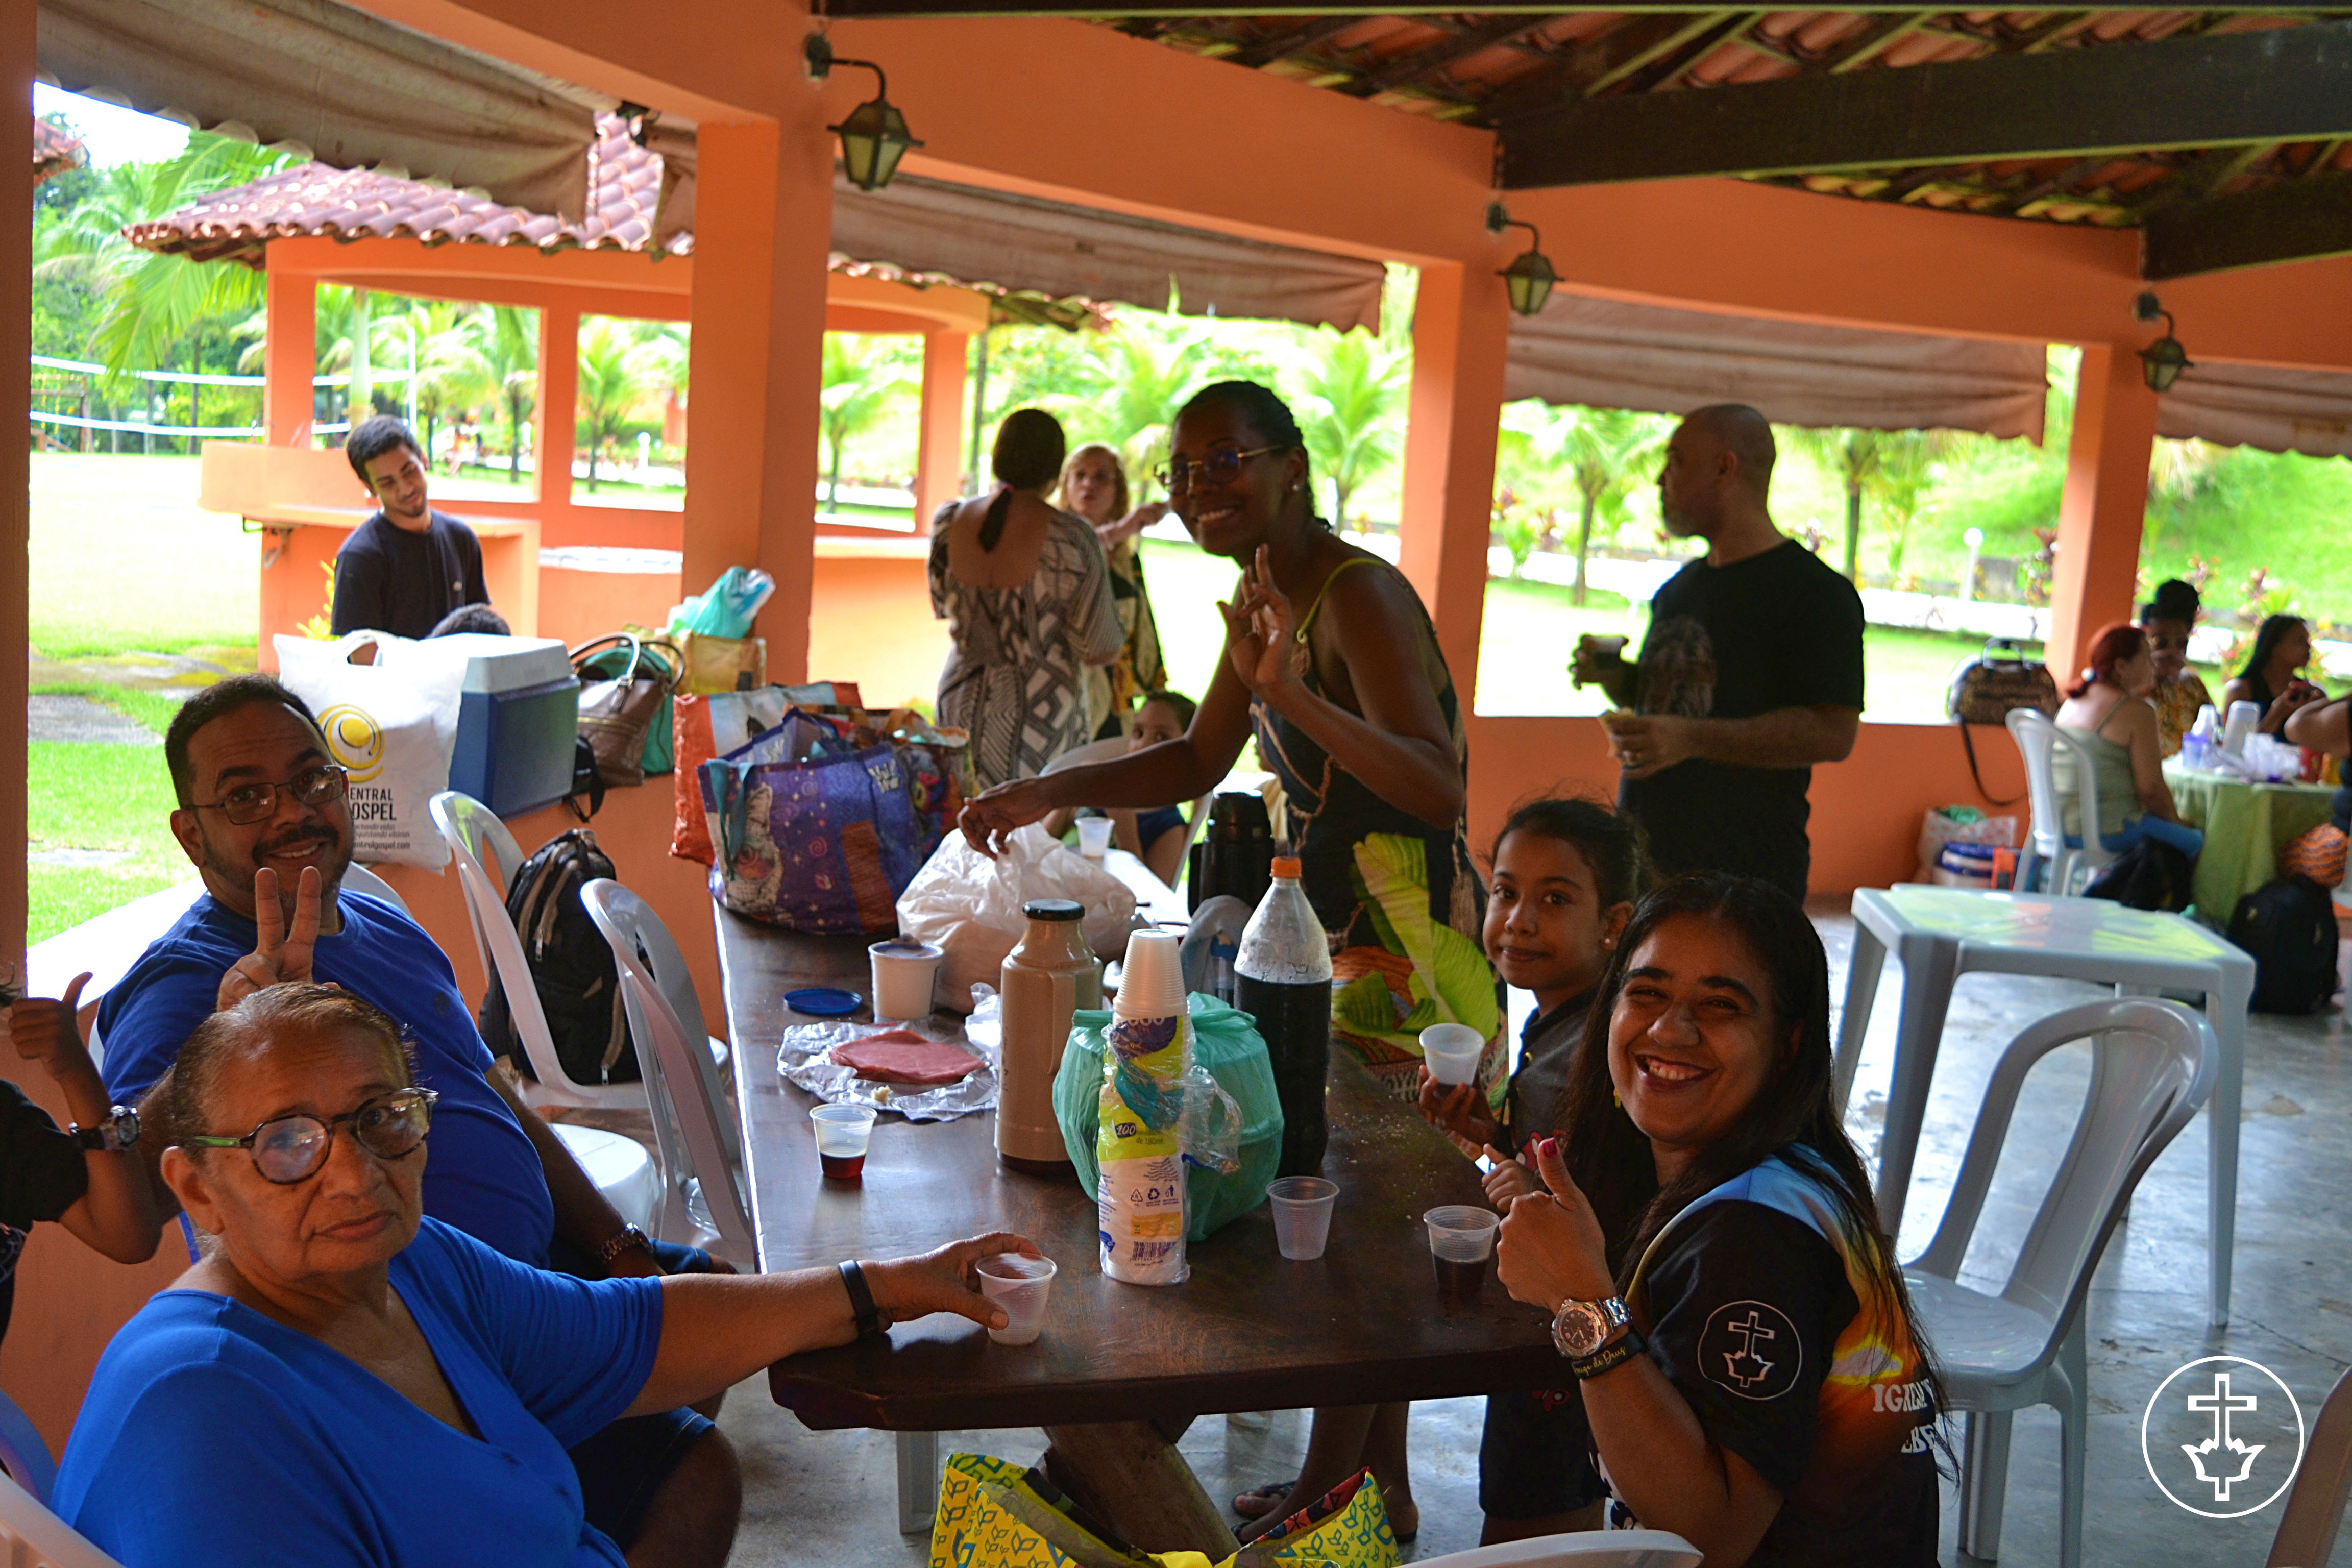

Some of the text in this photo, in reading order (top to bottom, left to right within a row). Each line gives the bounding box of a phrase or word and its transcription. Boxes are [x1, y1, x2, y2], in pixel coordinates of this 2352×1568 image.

[350, 787, 394, 801] ENTRAL
[352, 802, 397, 821] OSPEL
[1116, 1124, 1136, 1136] 100
[1602, 1348, 1626, 1364] Deus
